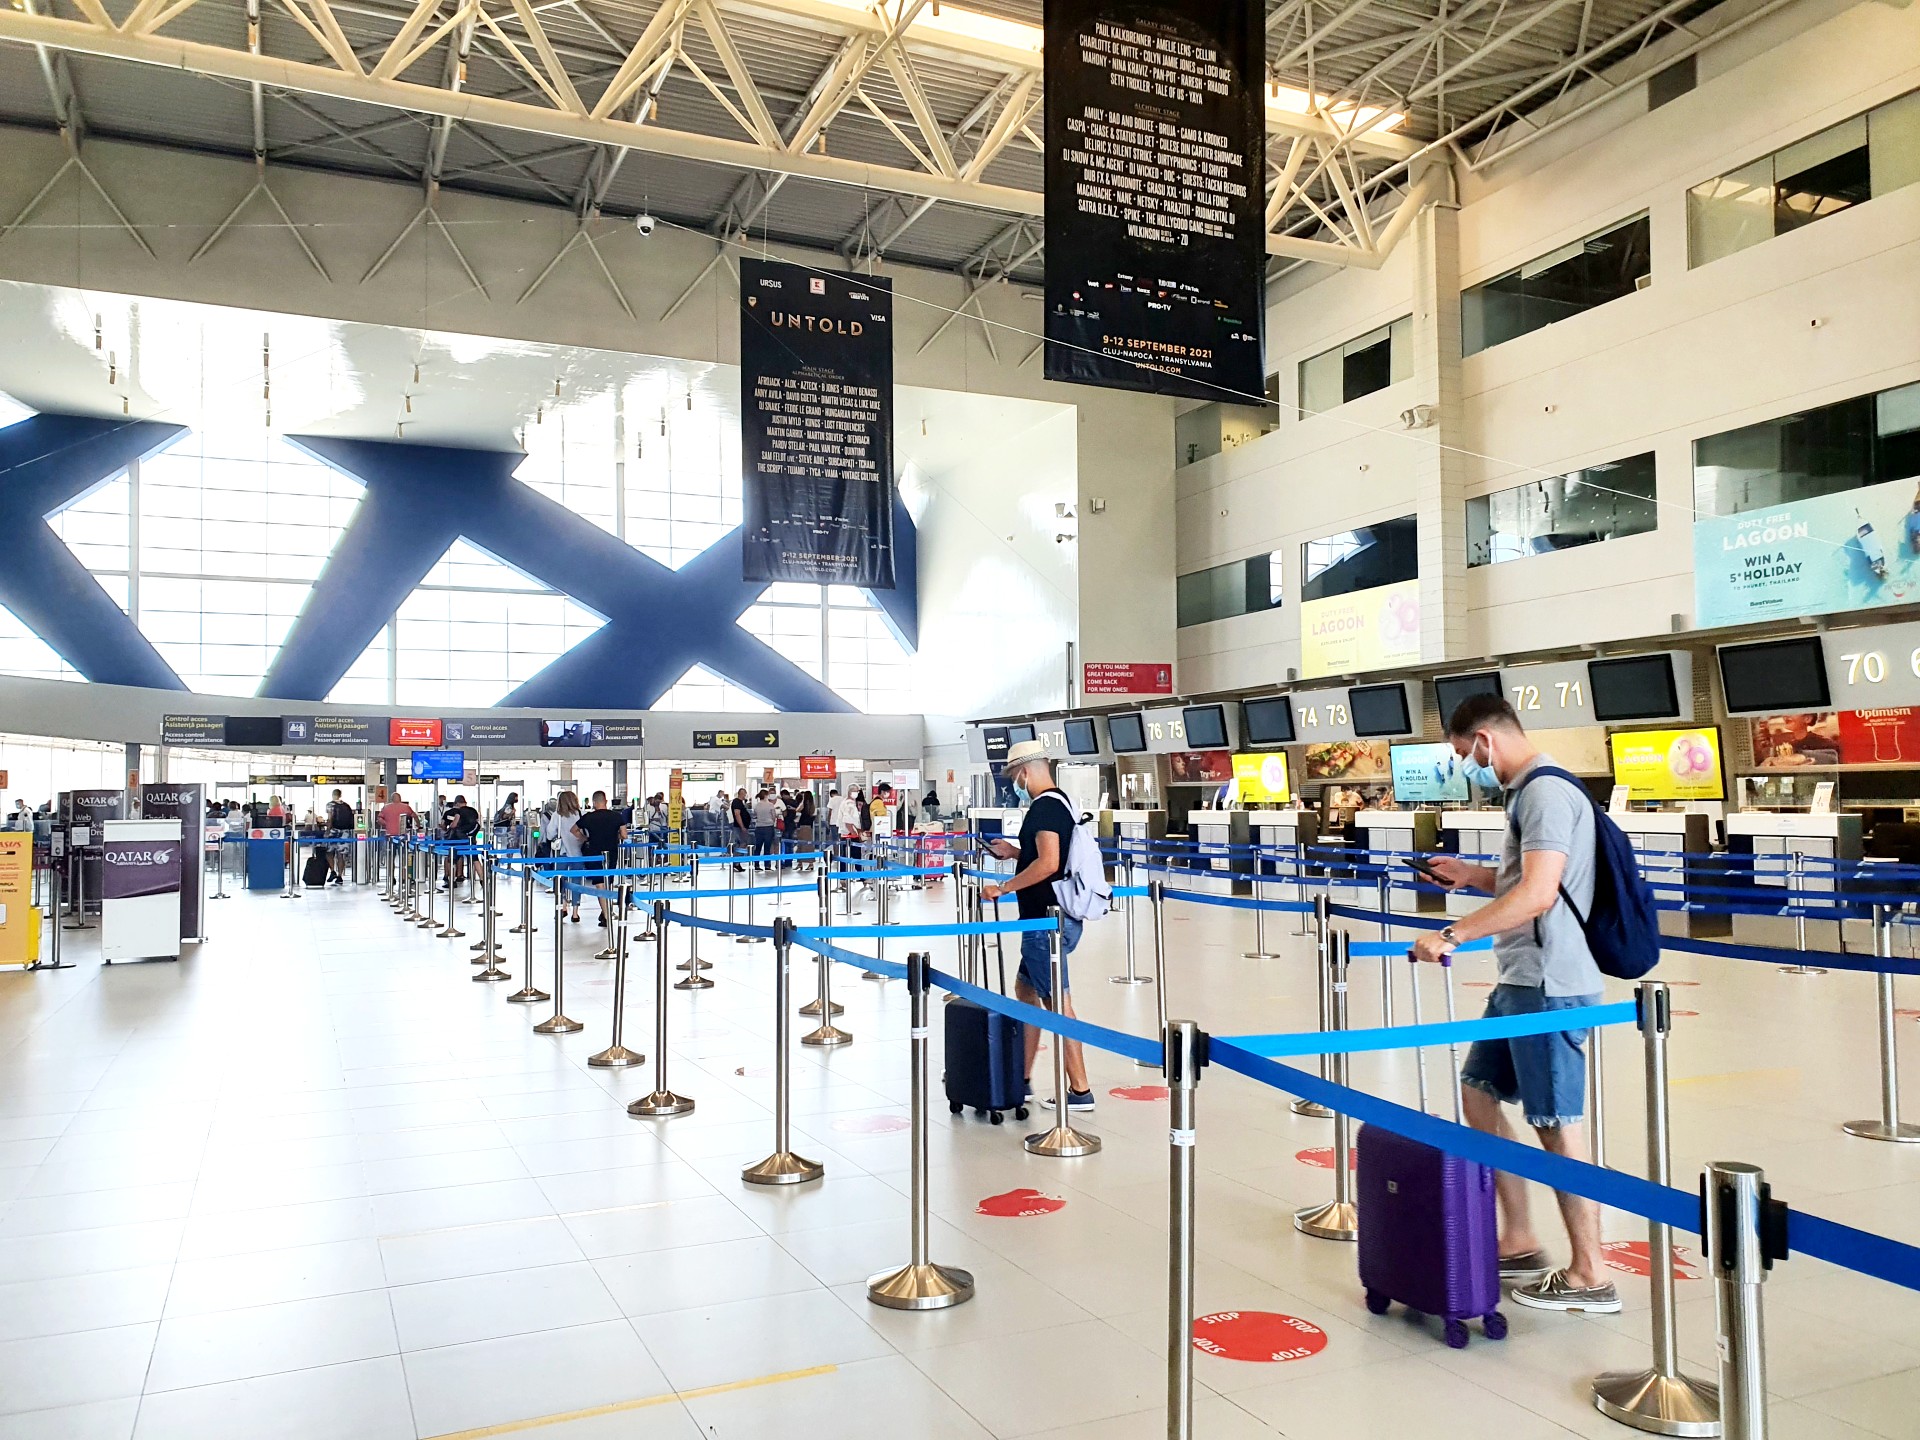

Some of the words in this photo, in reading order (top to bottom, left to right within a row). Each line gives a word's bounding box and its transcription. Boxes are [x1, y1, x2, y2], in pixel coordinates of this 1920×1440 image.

[1160, 24, 1177, 32] STAGE
[1096, 23, 1110, 37] PAUL
[1111, 26, 1151, 46] KALKBRENNER
[1156, 37, 1176, 52] AMELIE
[1178, 42, 1191, 56] LENS
[1080, 34, 1111, 53] CHARLOTTE
[1112, 42, 1120, 55] DE
[1121, 44, 1138, 59] WITTE
[1143, 49, 1161, 64] COLYN
[1162, 54, 1178, 68] JAMIE
[1179, 58, 1196, 73] JONES
[1204, 64, 1218, 78] LOCO
[1082, 50, 1107, 68] MAHONY
[1112, 57, 1126, 72] NINA
[1128, 61, 1148, 77] KRAVIZ
[1153, 67, 1176, 83] PAN-POT
[1111, 73, 1124, 88] SETH
[1126, 77, 1150, 93] TROXLER
[1155, 83, 1167, 97] TALE
[1169, 86, 1176, 99] OF
[1177, 88, 1184, 101] US
[1189, 91, 1202, 105] YAYA
[1084, 106, 1104, 122] AMULY
[1109, 111, 1120, 125] BAD
[1121, 114, 1133, 128] AND
[1134, 117, 1154, 133] BOUJEE
[1181, 127, 1197, 142] CAMO
[1198, 130, 1202, 143] &
[1204, 132, 1228, 148] KROOKED
[1085, 137, 1106, 153] DELIRIC
[1107, 142, 1112, 154] X
[1113, 143, 1132, 158] SILENT
[1132, 147, 1152, 163] STRIKE
[1157, 152, 1197, 172] DIRTYPHONICS
[1202, 161, 1208, 174] DJ
[1209, 162, 1228, 178] SHIVER
[760, 279, 782, 288] URSUS
[771, 311, 863, 336] UNTOLD
[870, 314, 886, 322] VISA
[1103, 335, 1123, 346] 9-12
[1127, 339, 1186, 355] SEPTEMBER
[1190, 348, 1212, 359] 2021
[1102, 347, 1153, 361] CLUJ-NAPOCA
[1161, 355, 1212, 368] TRANSYLVANIA
[1135, 362, 1181, 374] UNTOLD.COM
[758, 376, 780, 387] AFROJACK
[784, 379, 796, 388] ALOK
[800, 381, 818, 391] AZTECK
[822, 383, 825, 392] B
[826, 383, 840, 393] JONES
[843, 385, 858, 395] BENNY
[859, 387, 878, 397] BENASSI
[1738, 518, 1763, 530] DUTY
[1766, 512, 1791, 525] FREE
[1723, 521, 1808, 551] LAGOON
[781, 551, 797, 559] 9-12
[798, 552, 841, 561] SEPTEMBER
[1744, 554, 1771, 567] WIN
[1776, 552, 1785, 562] A
[1744, 562, 1802, 580] HOLIDAY
[1312, 615, 1364, 635] LAGOON
[1841, 653, 1884, 684] 70
[1512, 685, 1541, 711] 72
[1554, 682, 1583, 707] 71
[1297, 707, 1318, 728] 74
[1326, 704, 1348, 725] 73
[193, 722, 223, 730] pasageri
[1147, 723, 1162, 740] 76
[1167, 720, 1183, 739] 75
[1038, 733, 1050, 747] 78
[1053, 731, 1064, 746] 77
[1617, 754, 1664, 764] LAGOON
[77, 796, 106, 806] QATAR
[146, 793, 178, 803] QATAR
[378, 790, 385, 799] 4
[75, 813, 91, 821] Web
[105, 850, 152, 864] QATAR
[1018, 1207, 1050, 1217] STOP
[1202, 1312, 1239, 1324] STOP
[1282, 1318, 1320, 1334] STOP
[1271, 1347, 1312, 1361] STOP
